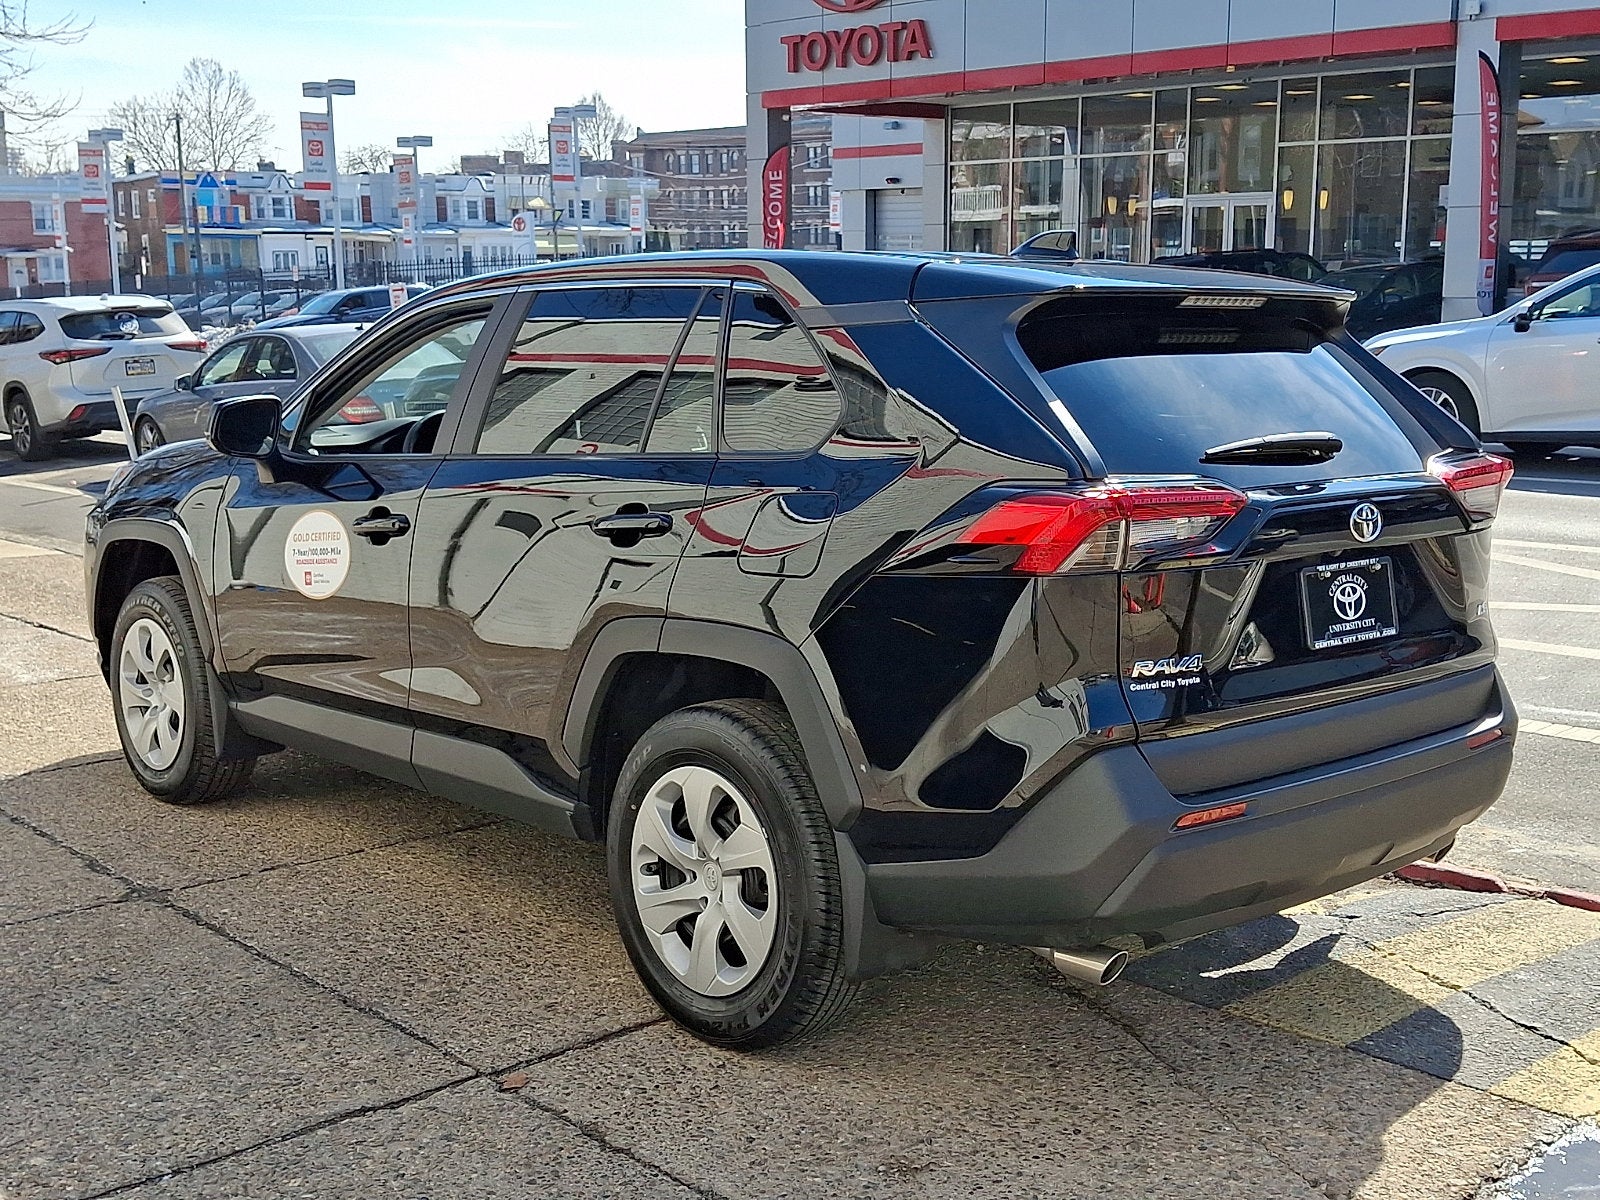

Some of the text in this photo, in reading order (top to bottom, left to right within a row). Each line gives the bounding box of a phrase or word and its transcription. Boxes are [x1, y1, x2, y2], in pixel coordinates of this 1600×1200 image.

[780, 19, 932, 73] TOYOTA
[764, 169, 783, 249] ELCOME
[293, 531, 341, 542] GOLD CERTIFIED
[1328, 573, 1369, 597] CENTRAL CITY
[1328, 618, 1376, 633] UNIVERSITY CITY
[1314, 637, 1342, 649] CENTRAL
[1342, 635, 1356, 643] CITY
[1357, 631, 1380, 641] TOYOTA
[1131, 653, 1203, 678] RAV4
[1130, 676, 1200, 691] Central City Toyota
